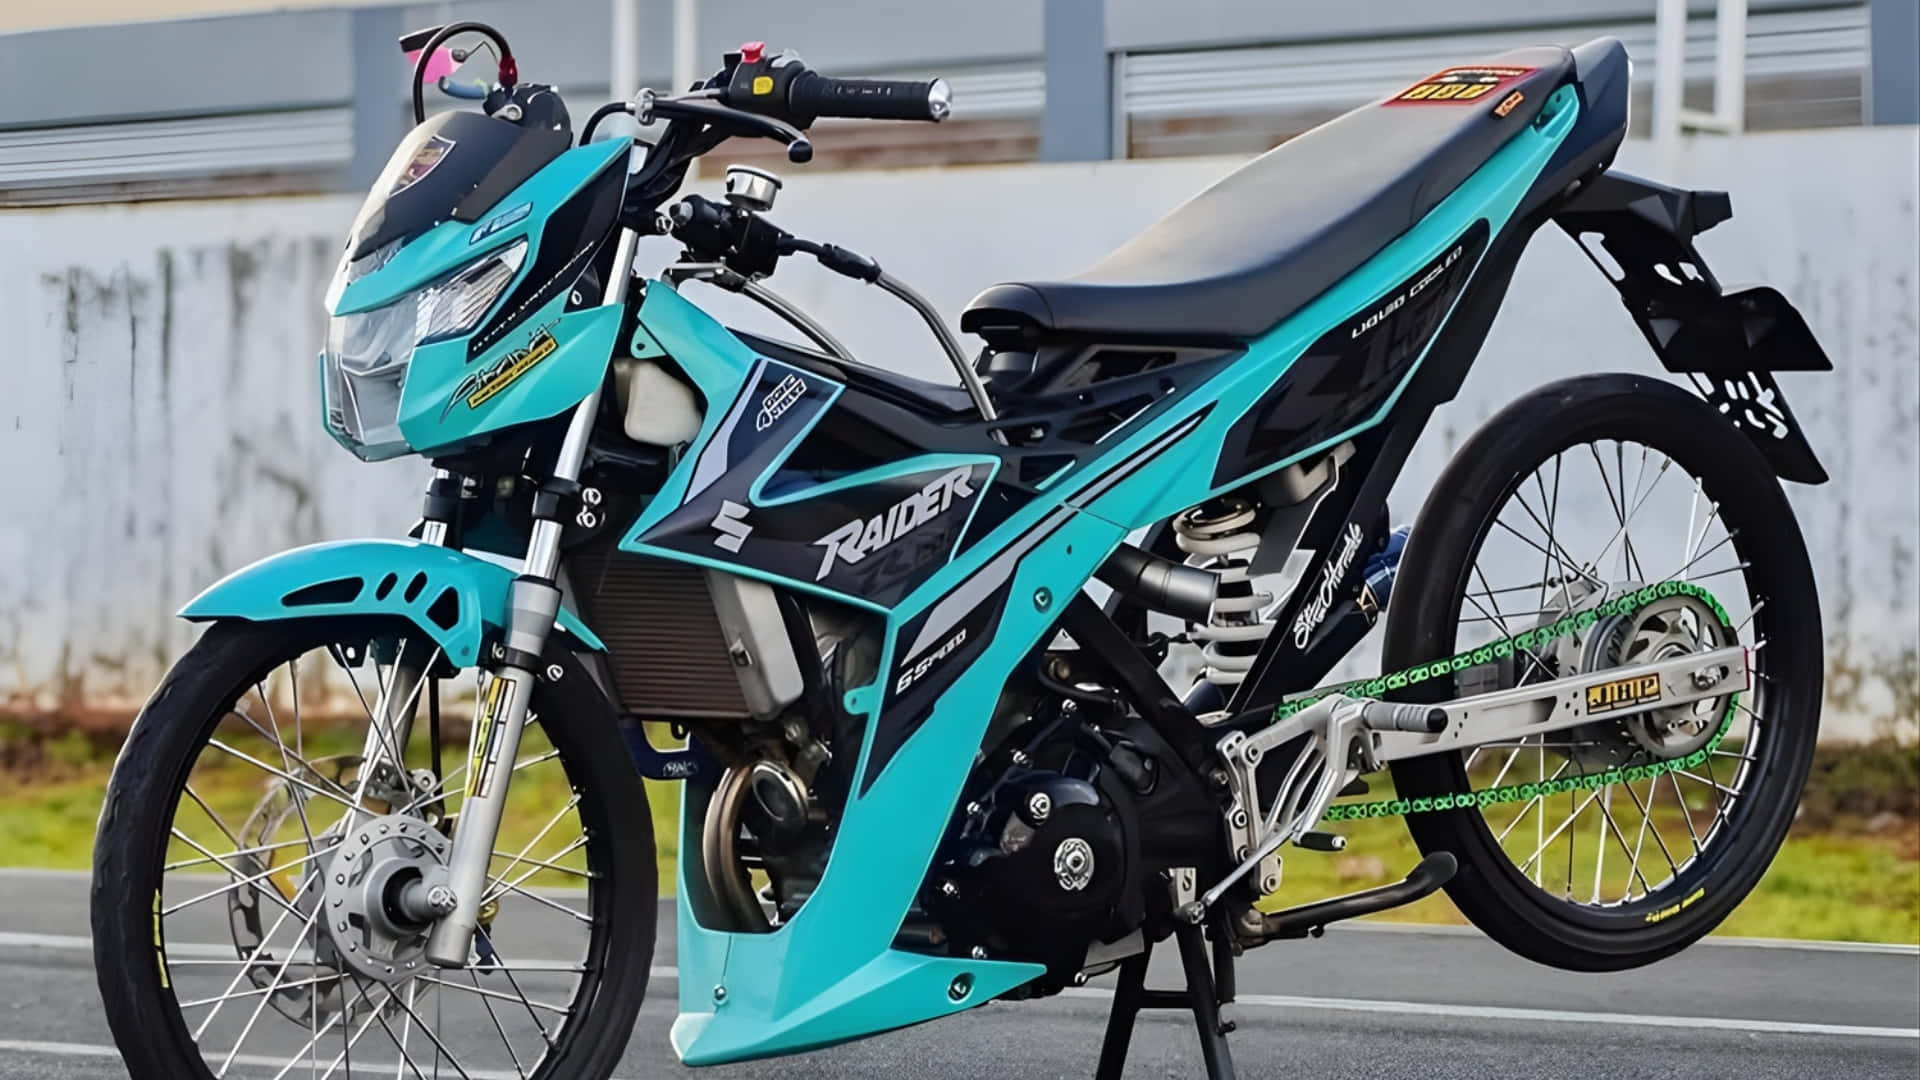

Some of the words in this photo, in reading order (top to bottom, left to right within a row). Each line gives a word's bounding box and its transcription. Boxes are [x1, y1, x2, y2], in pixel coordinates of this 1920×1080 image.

[1351, 293, 1406, 339] LIQUID
[812, 464, 975, 582] RAIDER
[895, 667, 915, 695] 6
